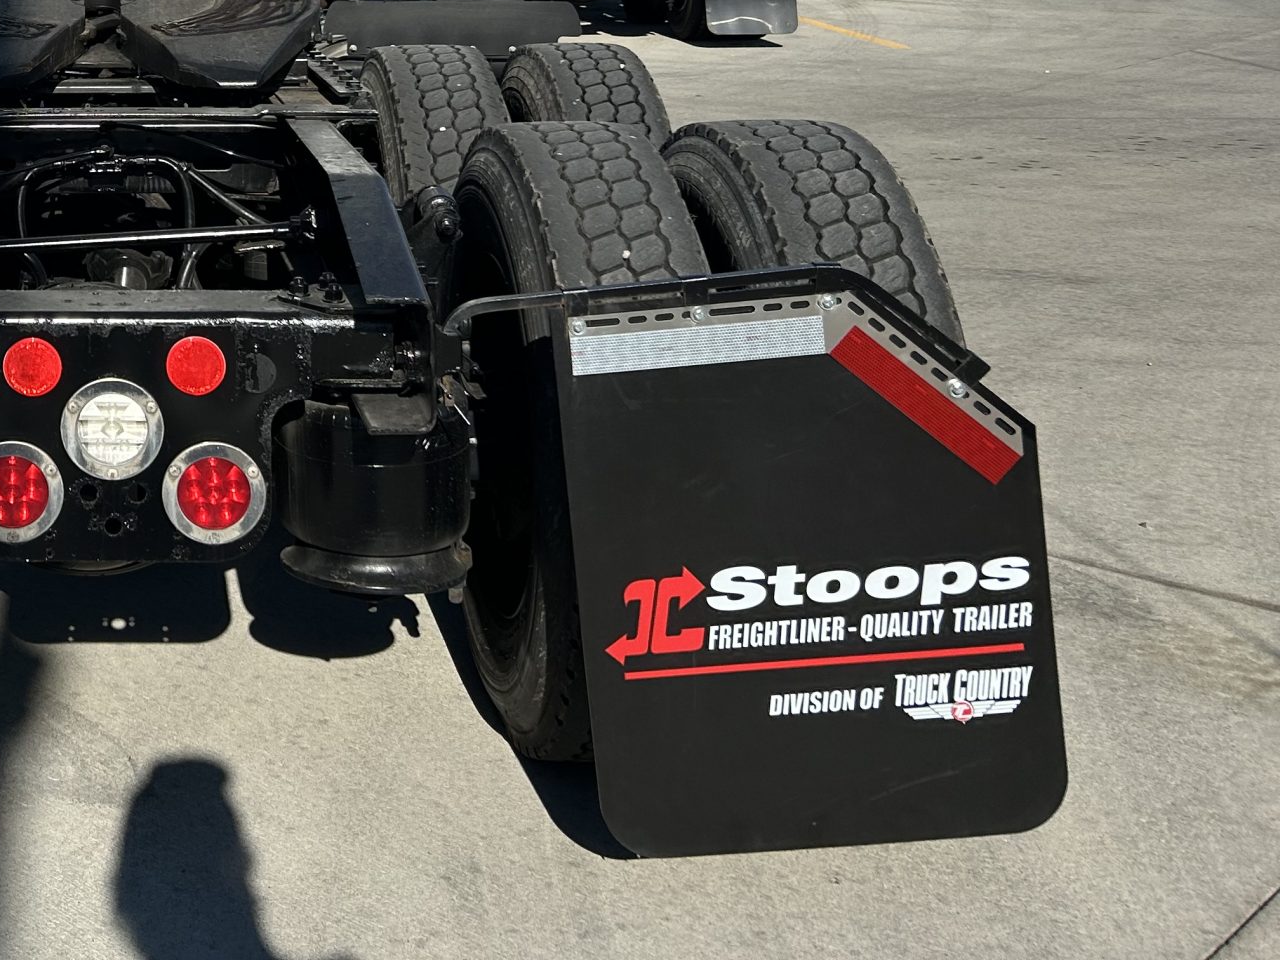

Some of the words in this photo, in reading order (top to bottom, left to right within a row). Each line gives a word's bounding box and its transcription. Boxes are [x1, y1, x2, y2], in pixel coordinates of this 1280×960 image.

[706, 556, 1030, 611] Stoops
[952, 601, 1033, 633] TRAILER
[769, 689, 856, 716] DIVISION
[859, 687, 885, 710] OF
[894, 672, 951, 707] TRUCK
[953, 666, 1033, 702] COUNTRY
